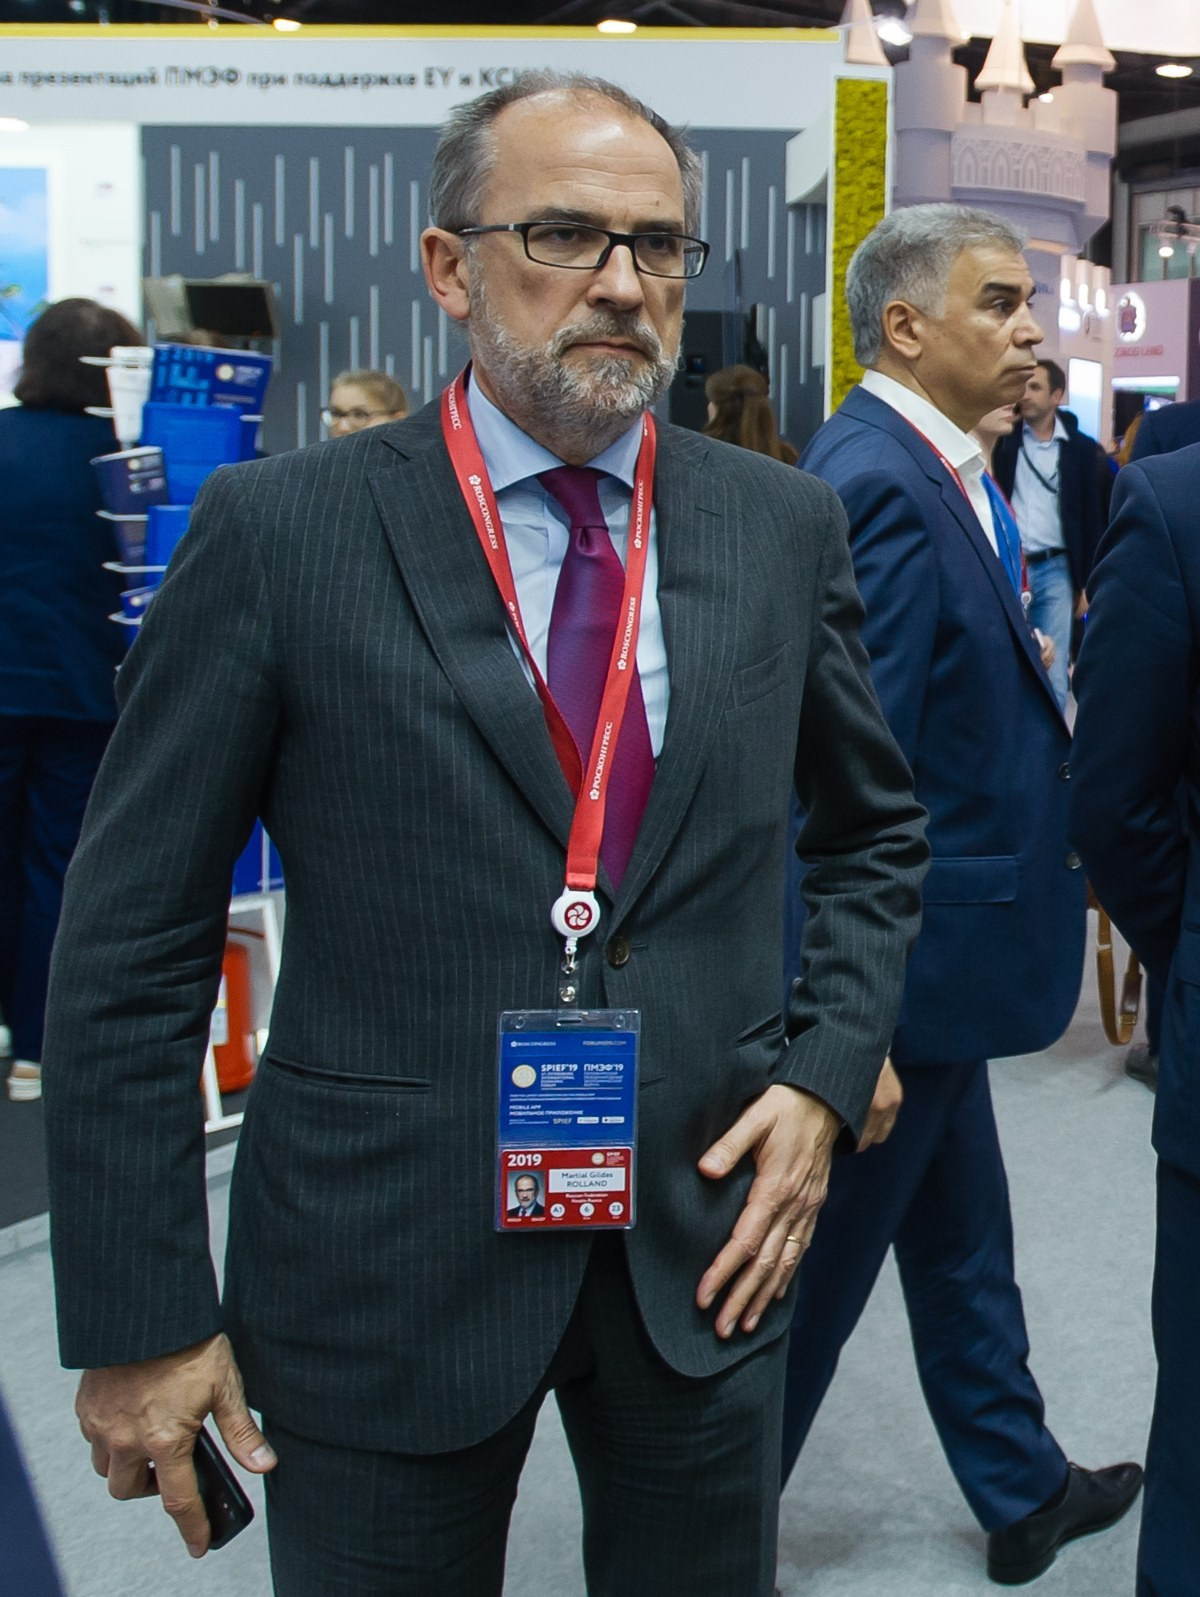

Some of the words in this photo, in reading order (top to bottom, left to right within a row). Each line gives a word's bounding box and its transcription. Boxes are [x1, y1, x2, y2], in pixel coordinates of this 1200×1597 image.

[20, 67, 157, 90] презентаций
[165, 66, 240, 87] ПМЭФ
[248, 72, 286, 91] при
[294, 72, 417, 91] поддержке
[472, 483, 499, 550] ROSCONGRESS
[621, 596, 637, 661] ROSCONGRESS
[593, 721, 613, 790] РОСКОНГРЕСС
[541, 1063, 578, 1072] SPIEF'19
[583, 1063, 624, 1072] ПМЭФ'19
[507, 1153, 542, 1167] 2019
[589, 1171, 613, 1179] Gildas
[566, 1180, 607, 1188] ROLLAND
[583, 1205, 590, 1213] 6
